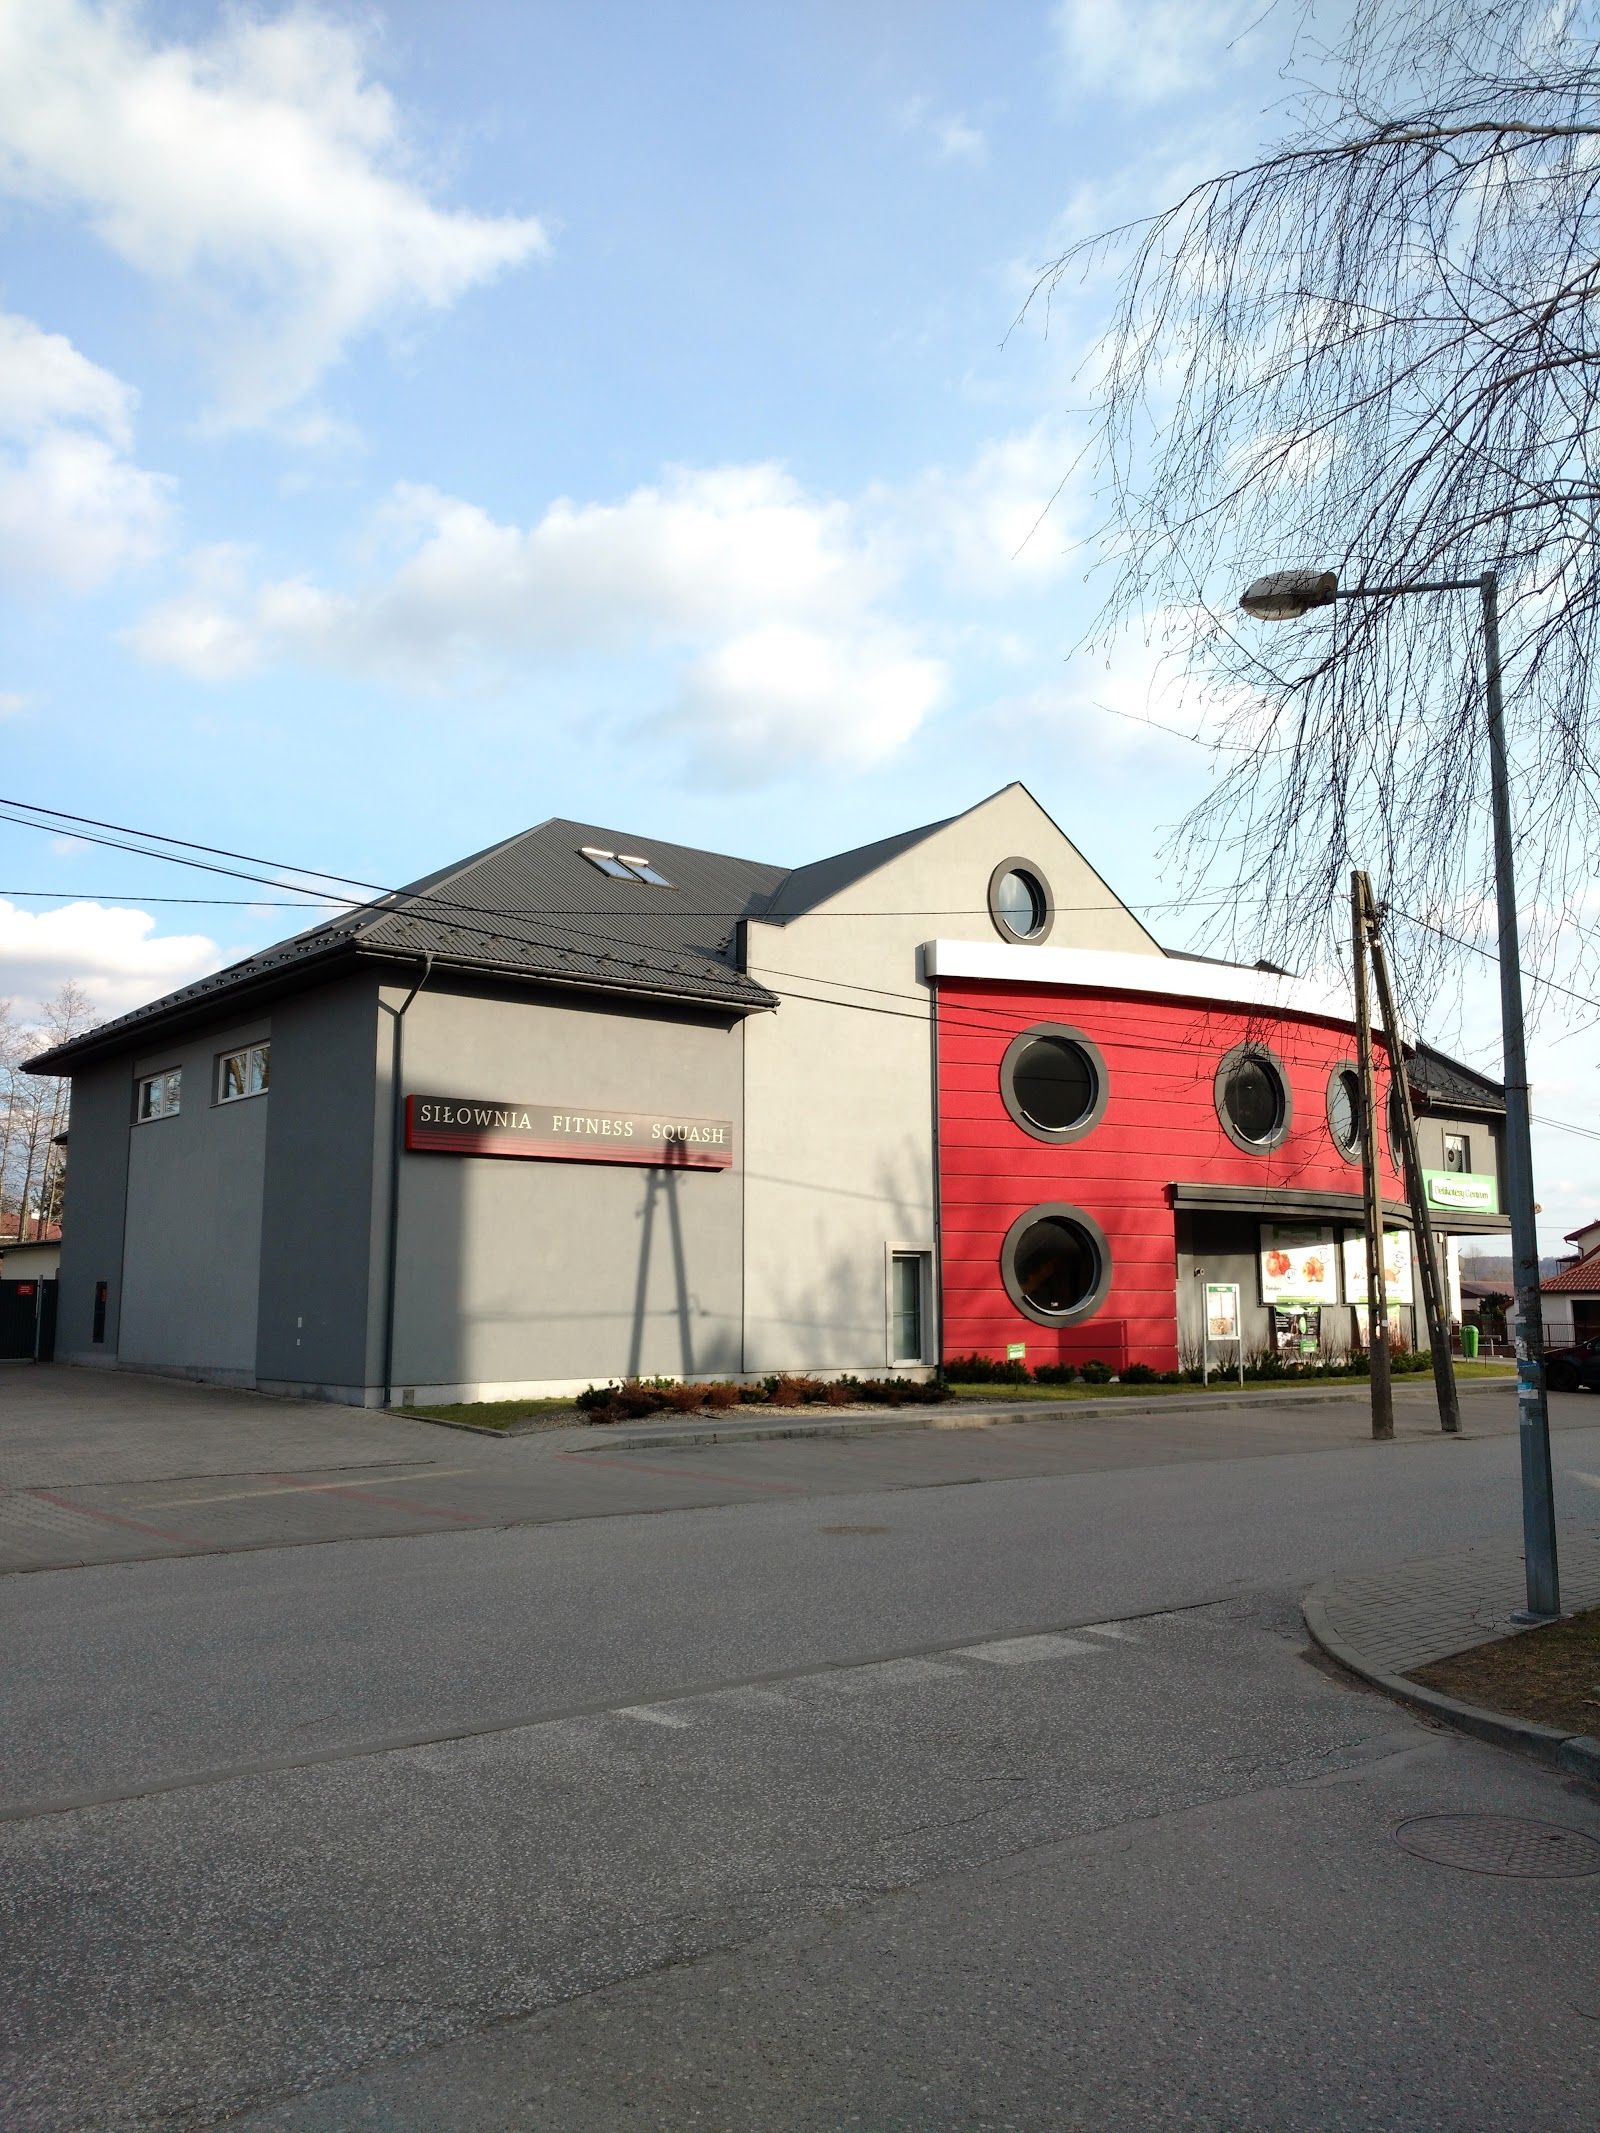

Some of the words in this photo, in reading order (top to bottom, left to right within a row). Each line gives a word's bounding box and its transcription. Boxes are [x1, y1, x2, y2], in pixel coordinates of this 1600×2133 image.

[420, 1104, 532, 1129] SIŁOWNIA
[552, 1115, 634, 1137] FITNESS
[651, 1123, 724, 1144] SQUASH
